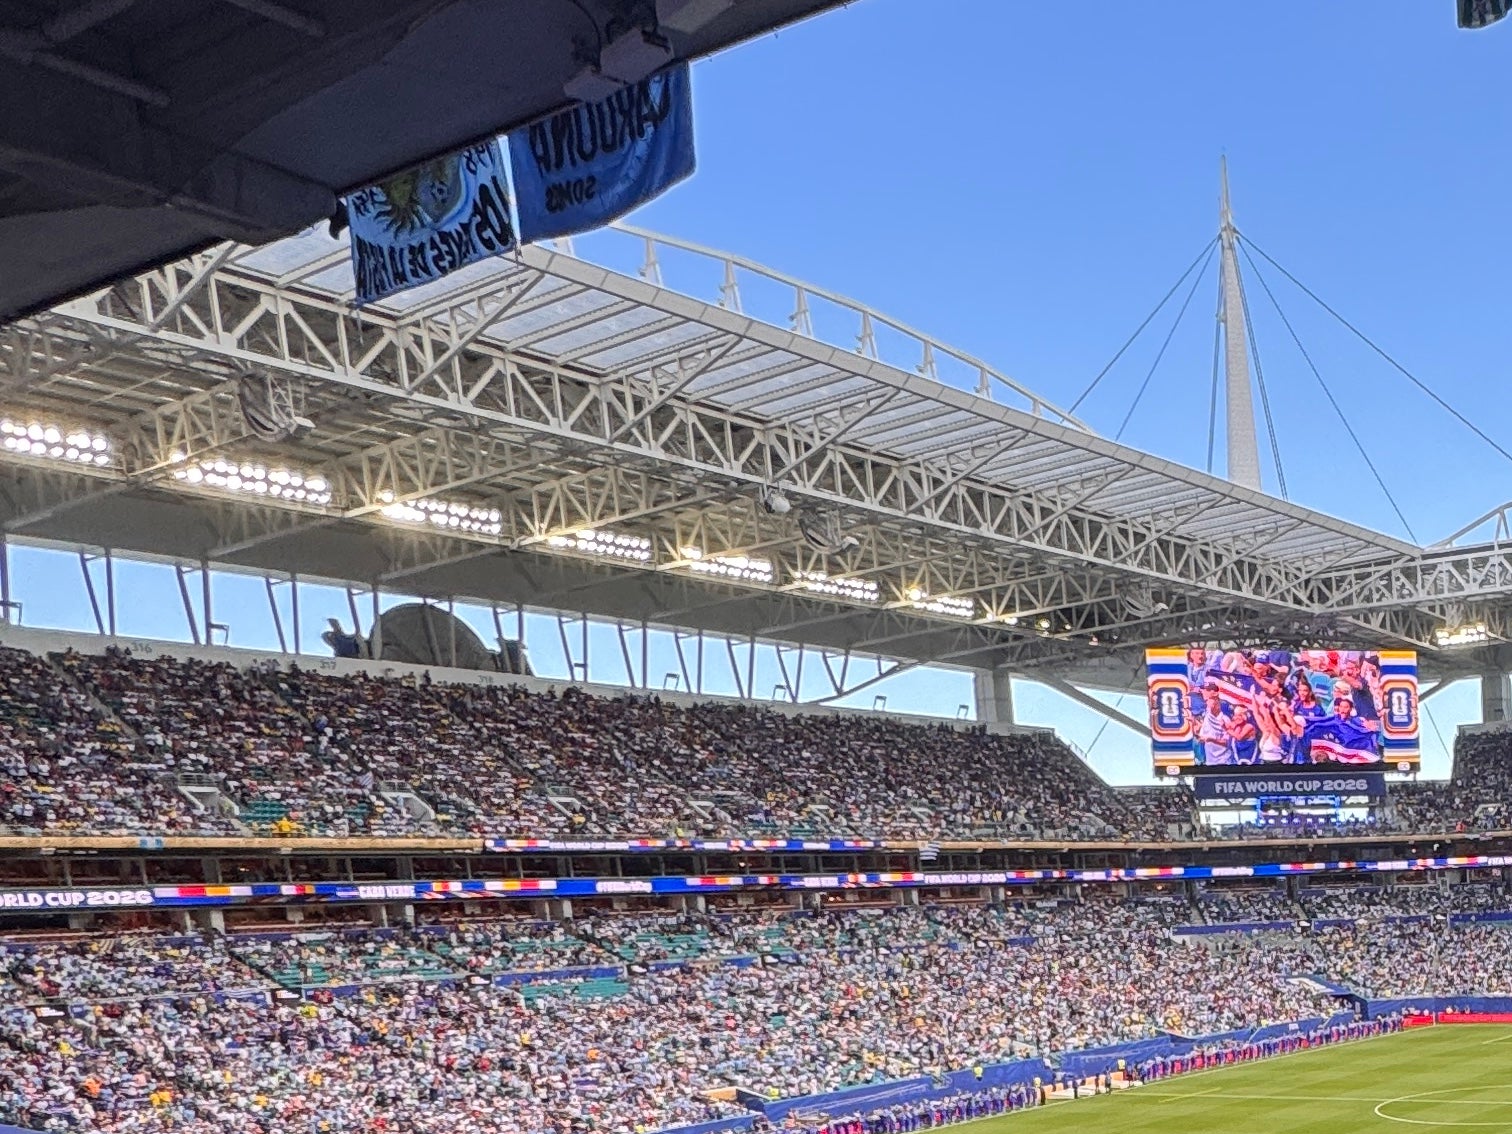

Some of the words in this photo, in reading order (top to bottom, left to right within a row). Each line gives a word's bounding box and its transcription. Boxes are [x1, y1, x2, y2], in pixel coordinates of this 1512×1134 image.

[1214, 782, 1244, 794] FIFA
[1245, 781, 1293, 793] WORLD
[1295, 780, 1321, 791] CUP
[1323, 779, 1368, 791] 2026
[45, 892, 85, 906] CUP
[87, 890, 153, 905] 2026
